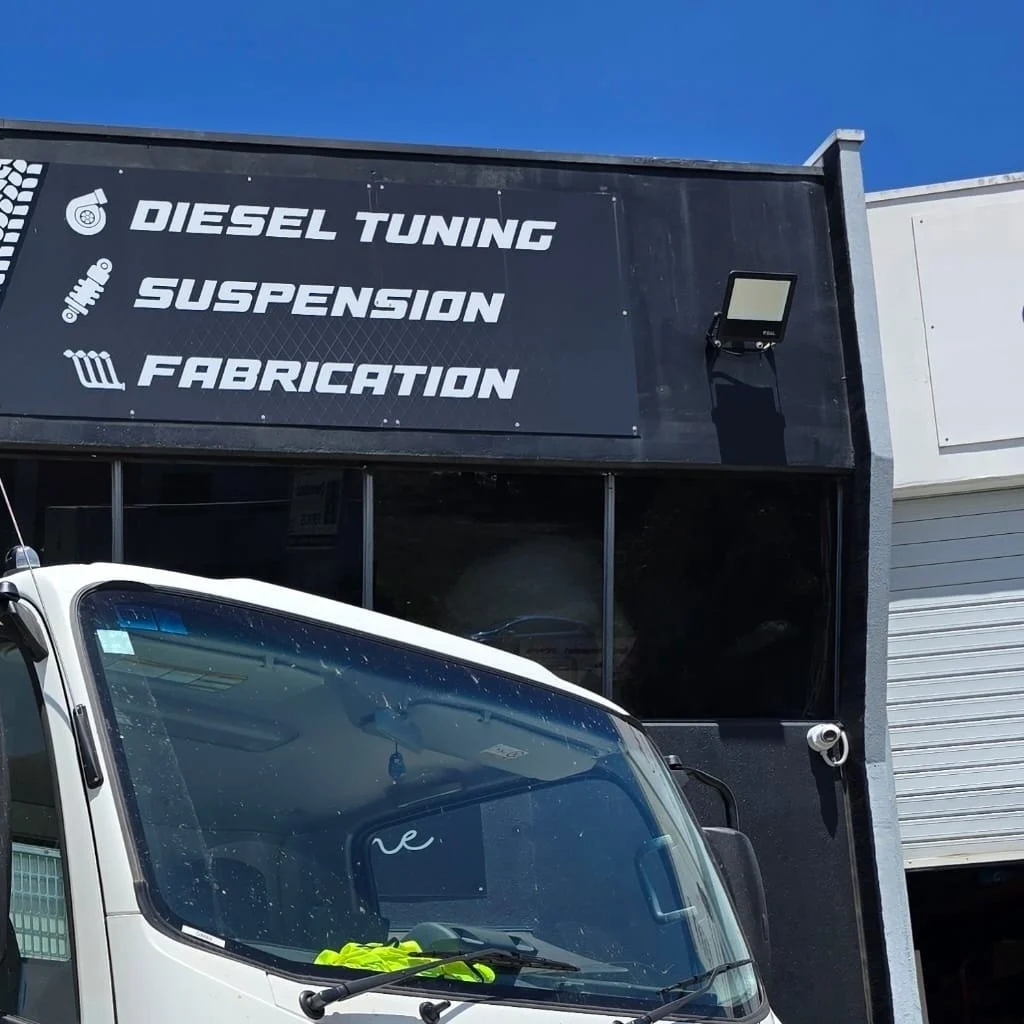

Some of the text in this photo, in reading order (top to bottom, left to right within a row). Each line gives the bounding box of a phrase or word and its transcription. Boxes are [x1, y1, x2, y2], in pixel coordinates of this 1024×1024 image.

[130, 199, 557, 251] DIESEL TUNING
[133, 277, 505, 323] SUSPENSION
[136, 355, 520, 400] FABRICATION
